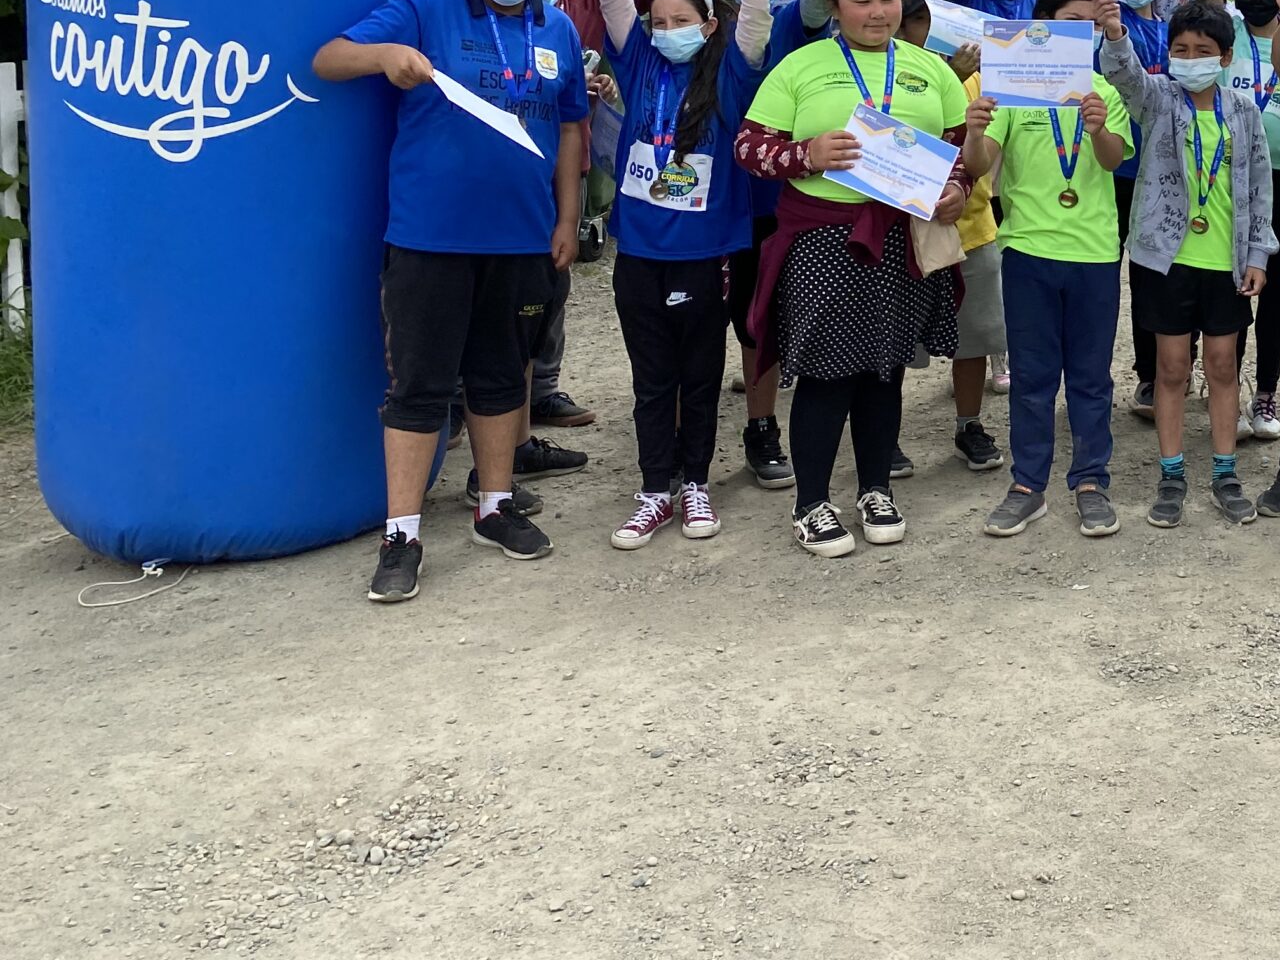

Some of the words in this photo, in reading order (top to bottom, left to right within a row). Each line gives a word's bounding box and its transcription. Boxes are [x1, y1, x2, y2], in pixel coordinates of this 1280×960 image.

[50, 0, 270, 163] contigo
[479, 68, 543, 96] ESCEA
[629, 161, 654, 182] 050
[661, 173, 695, 184] CORRIDA
